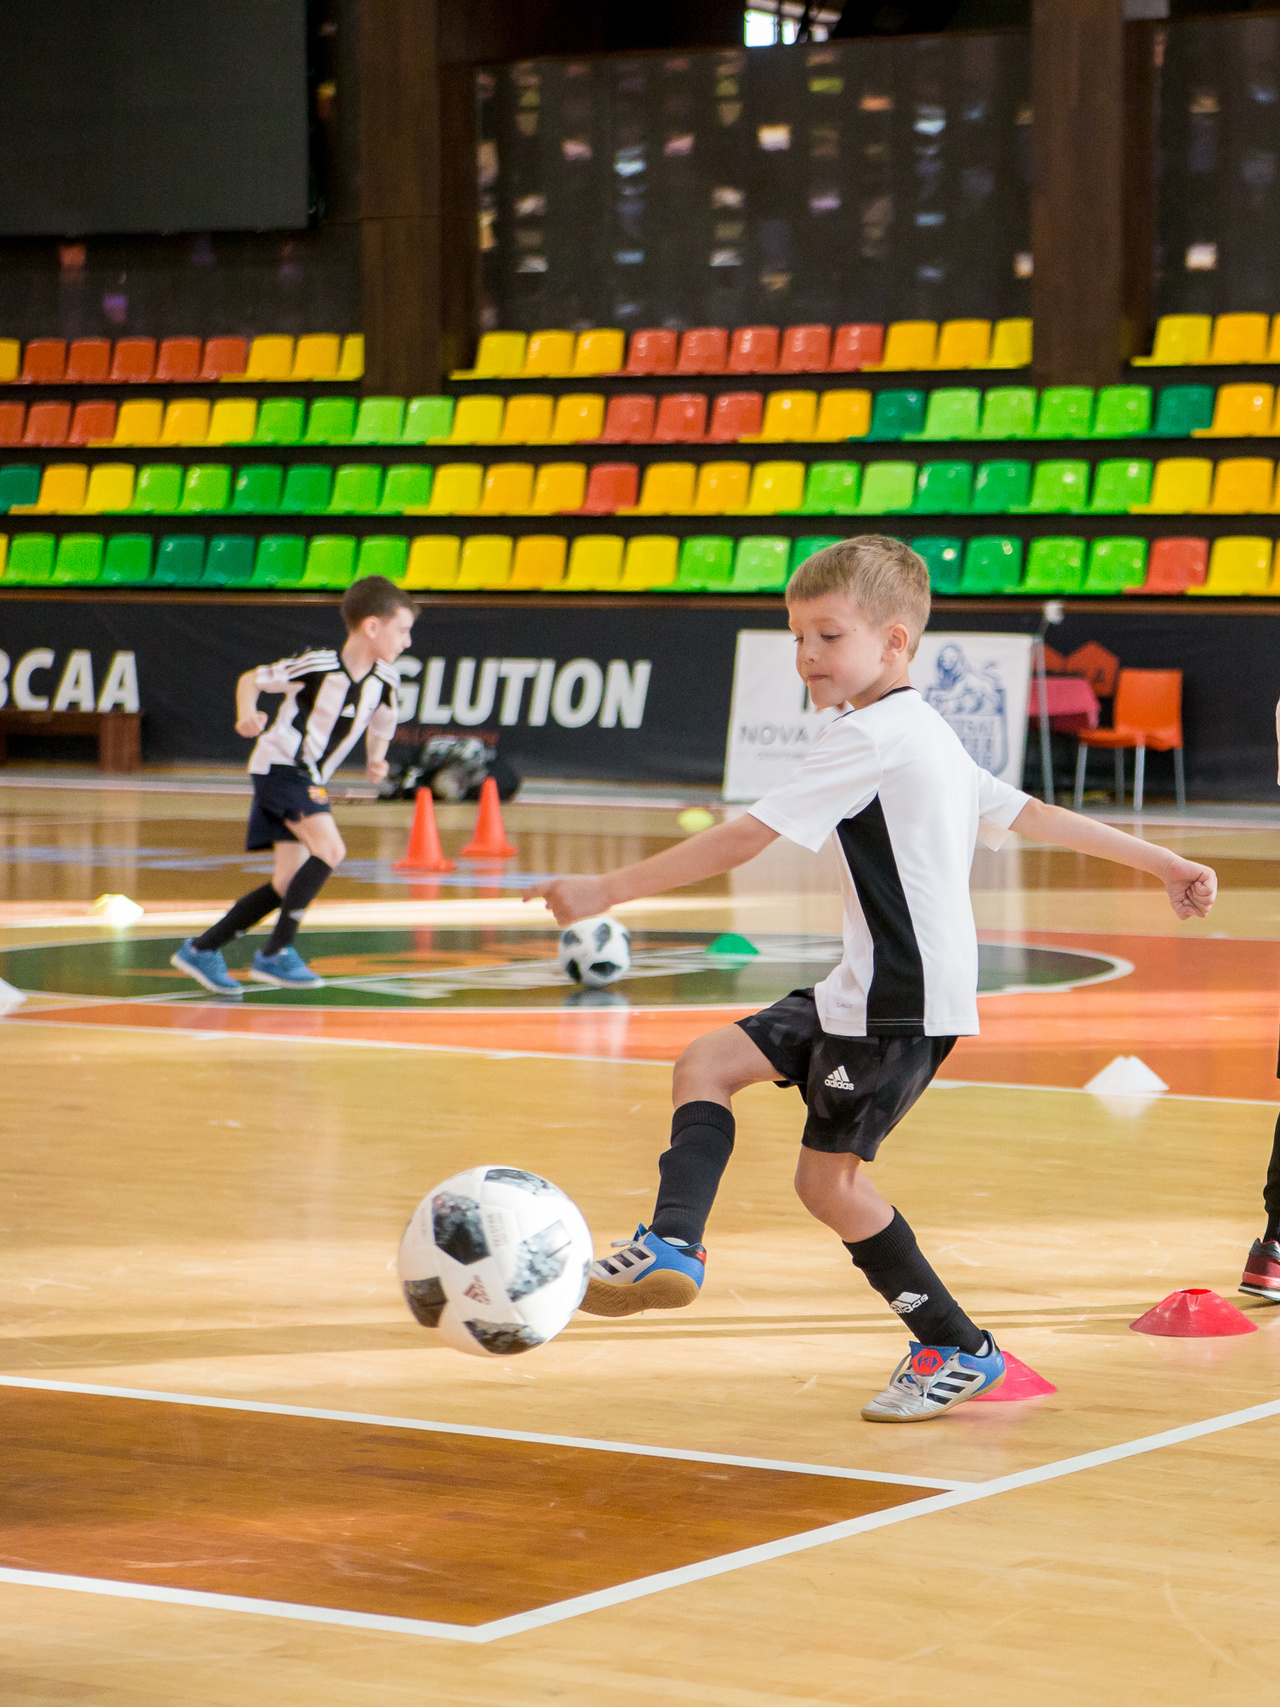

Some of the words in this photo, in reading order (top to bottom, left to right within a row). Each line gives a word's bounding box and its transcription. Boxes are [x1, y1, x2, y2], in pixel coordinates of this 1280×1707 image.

[0, 646, 140, 714] CAA
[738, 723, 810, 746] NOVA
[824, 1078, 855, 1091] adidas
